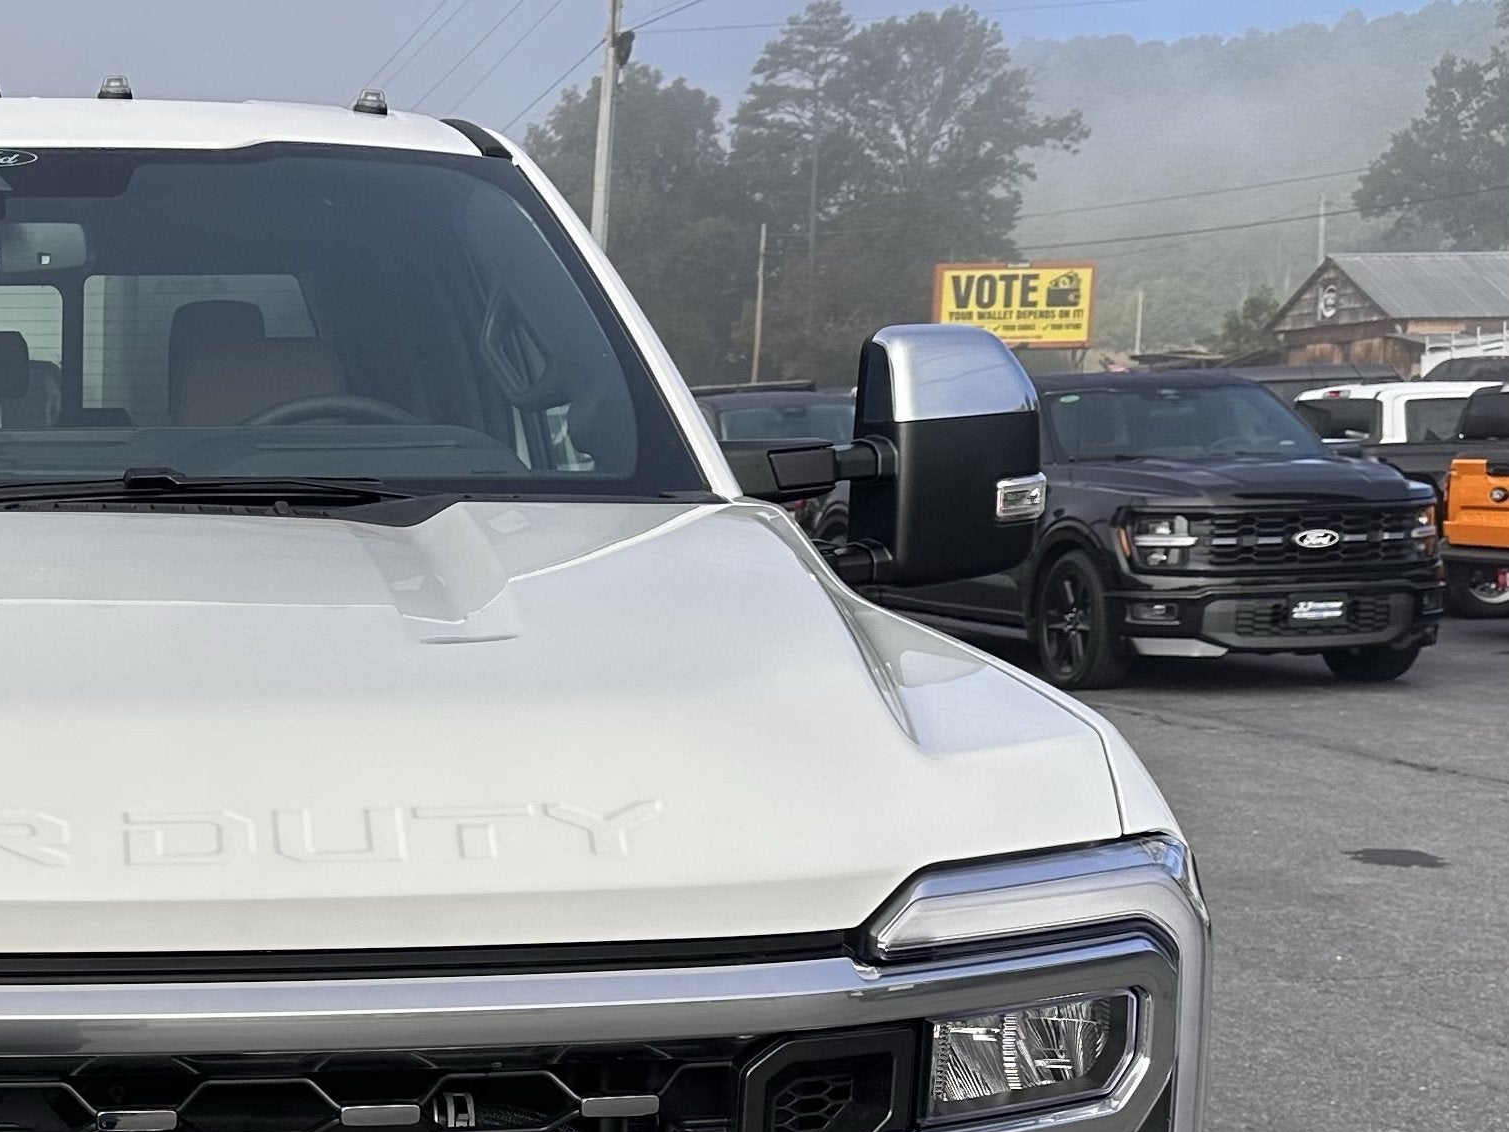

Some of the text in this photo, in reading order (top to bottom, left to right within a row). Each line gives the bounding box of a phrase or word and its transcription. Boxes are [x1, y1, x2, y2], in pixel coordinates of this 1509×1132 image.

[951, 274, 1040, 309] VOTE
[948, 311, 973, 321] YOUR
[977, 310, 1013, 320] WALLET
[1016, 309, 1056, 319] DEPENDS
[1058, 309, 1071, 318] ON
[123, 799, 664, 865] DUTY
